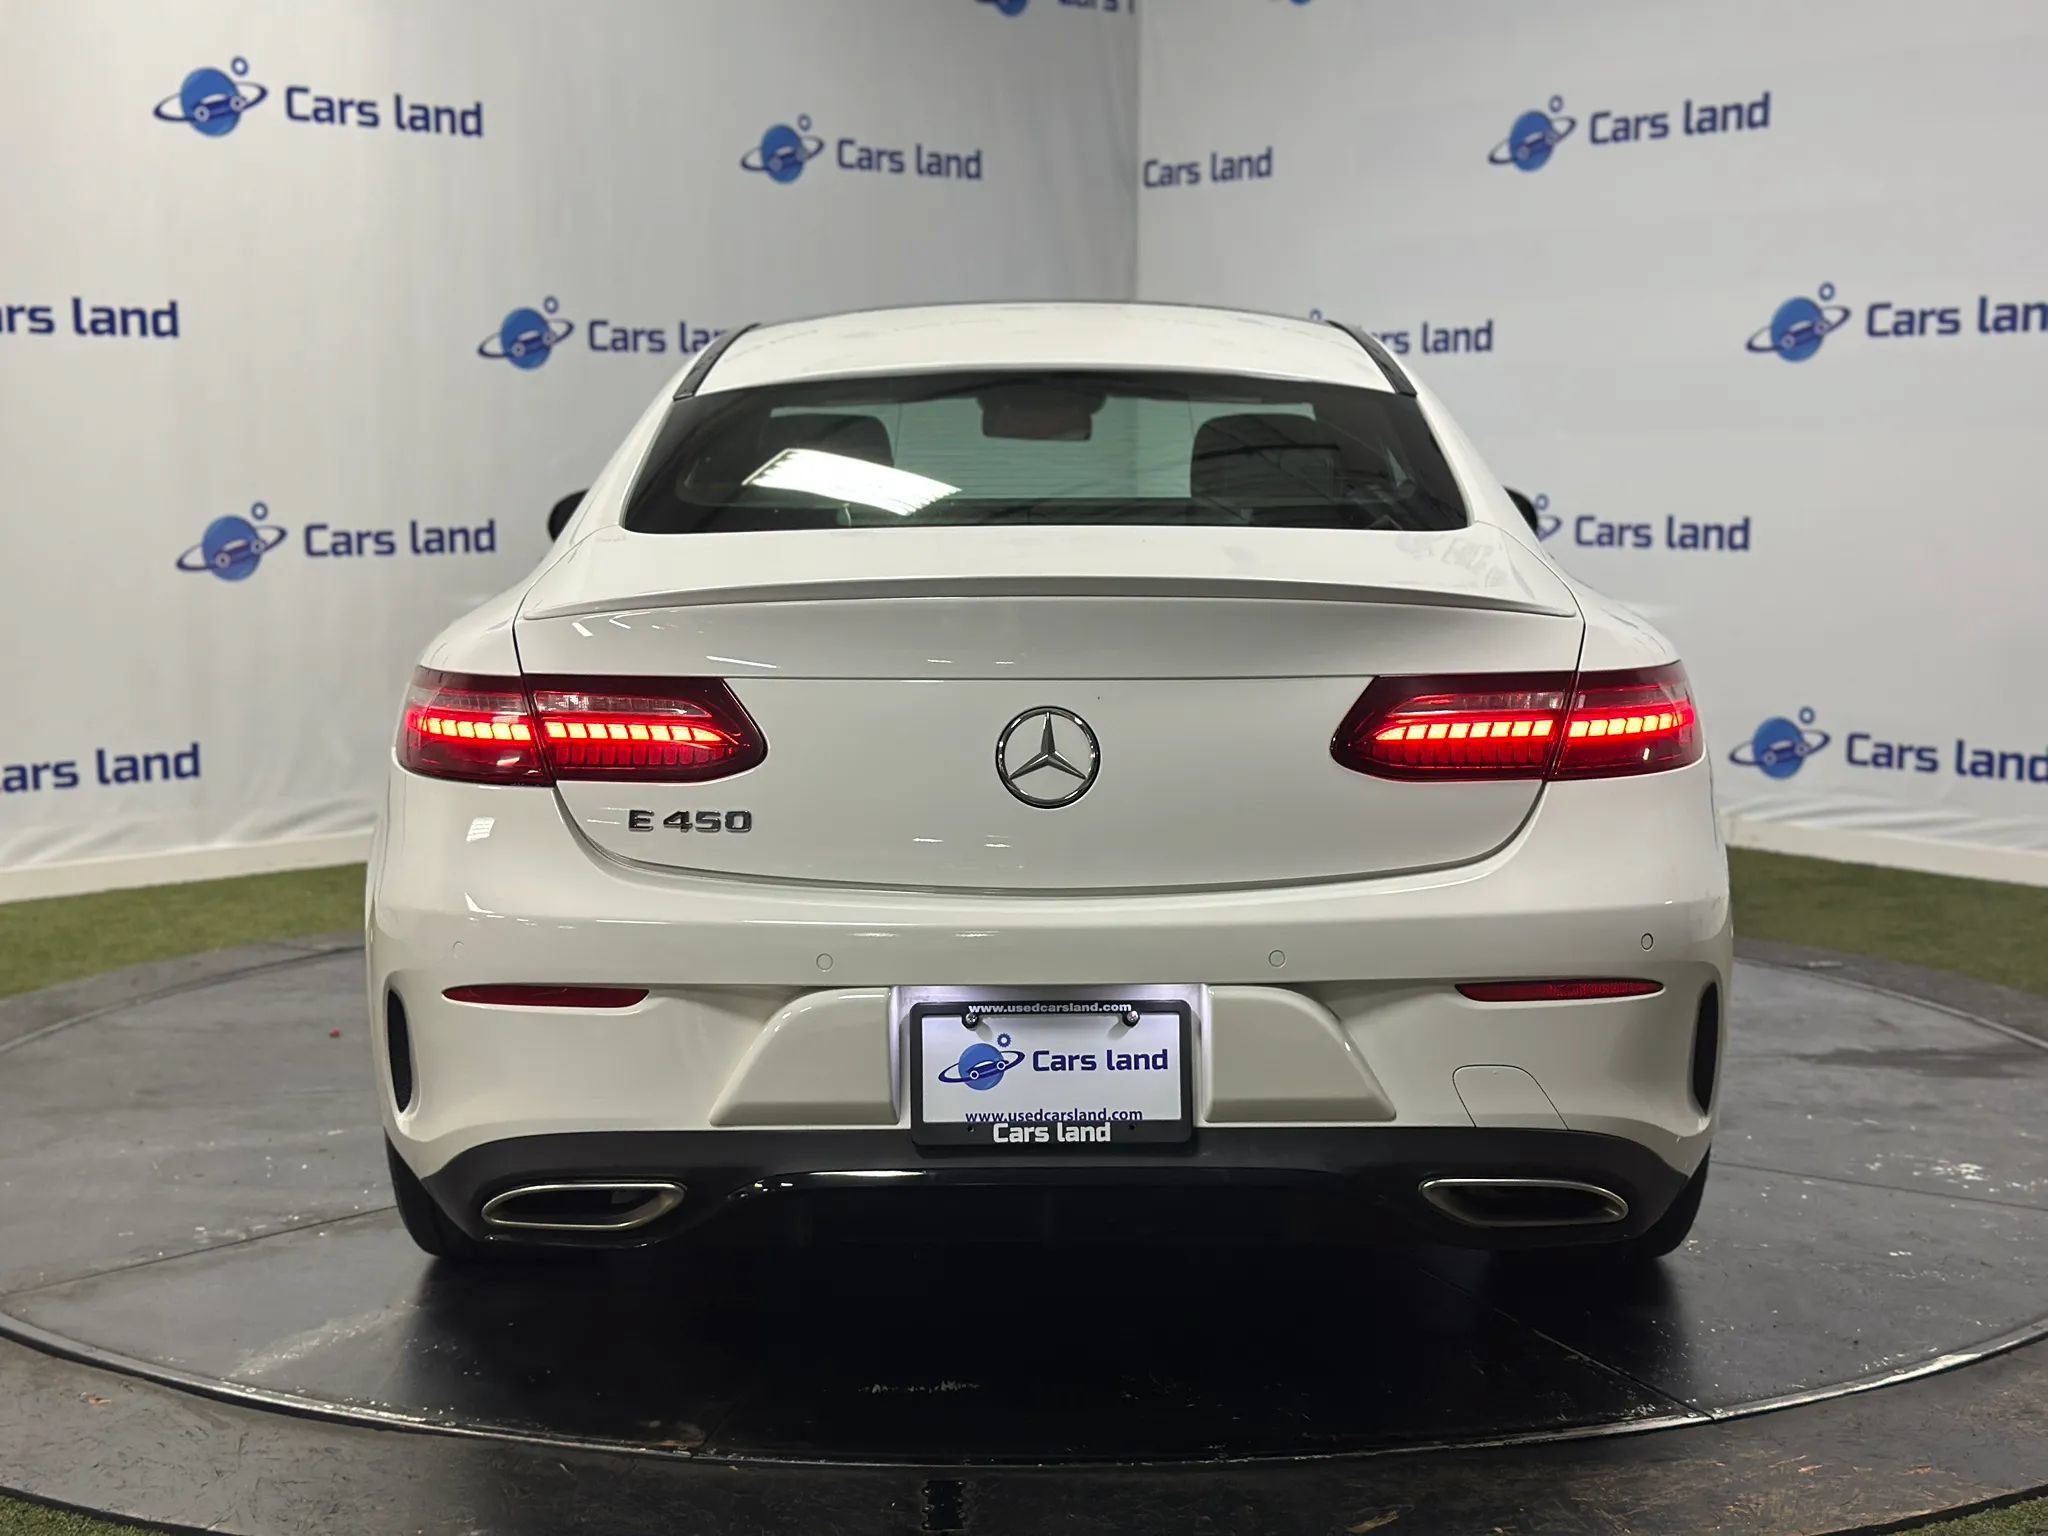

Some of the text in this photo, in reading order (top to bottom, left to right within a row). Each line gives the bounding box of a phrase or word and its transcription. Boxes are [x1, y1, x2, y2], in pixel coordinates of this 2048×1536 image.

[286, 86, 483, 137] Cars land
[1590, 92, 1770, 145] Cars land
[837, 139, 982, 180] Cars land
[1143, 147, 1272, 188] Cars land
[0, 297, 179, 337] rs land
[1867, 296, 2048, 337] Cars lan
[588, 320, 725, 353] Cars la
[1422, 320, 1493, 354] land
[304, 519, 496, 557] Cars land
[1575, 516, 1750, 551] Cars land
[0, 742, 200, 793] ars land
[1846, 733, 1939, 773] Cars
[629, 810, 752, 833] E 450
[968, 1002, 1132, 1013] www.usedcarsland.com
[1033, 1049, 1168, 1071] Cars land
[965, 1108, 1143, 1122] www.usedcarsland.com
[993, 1122, 1111, 1143] Cars land
